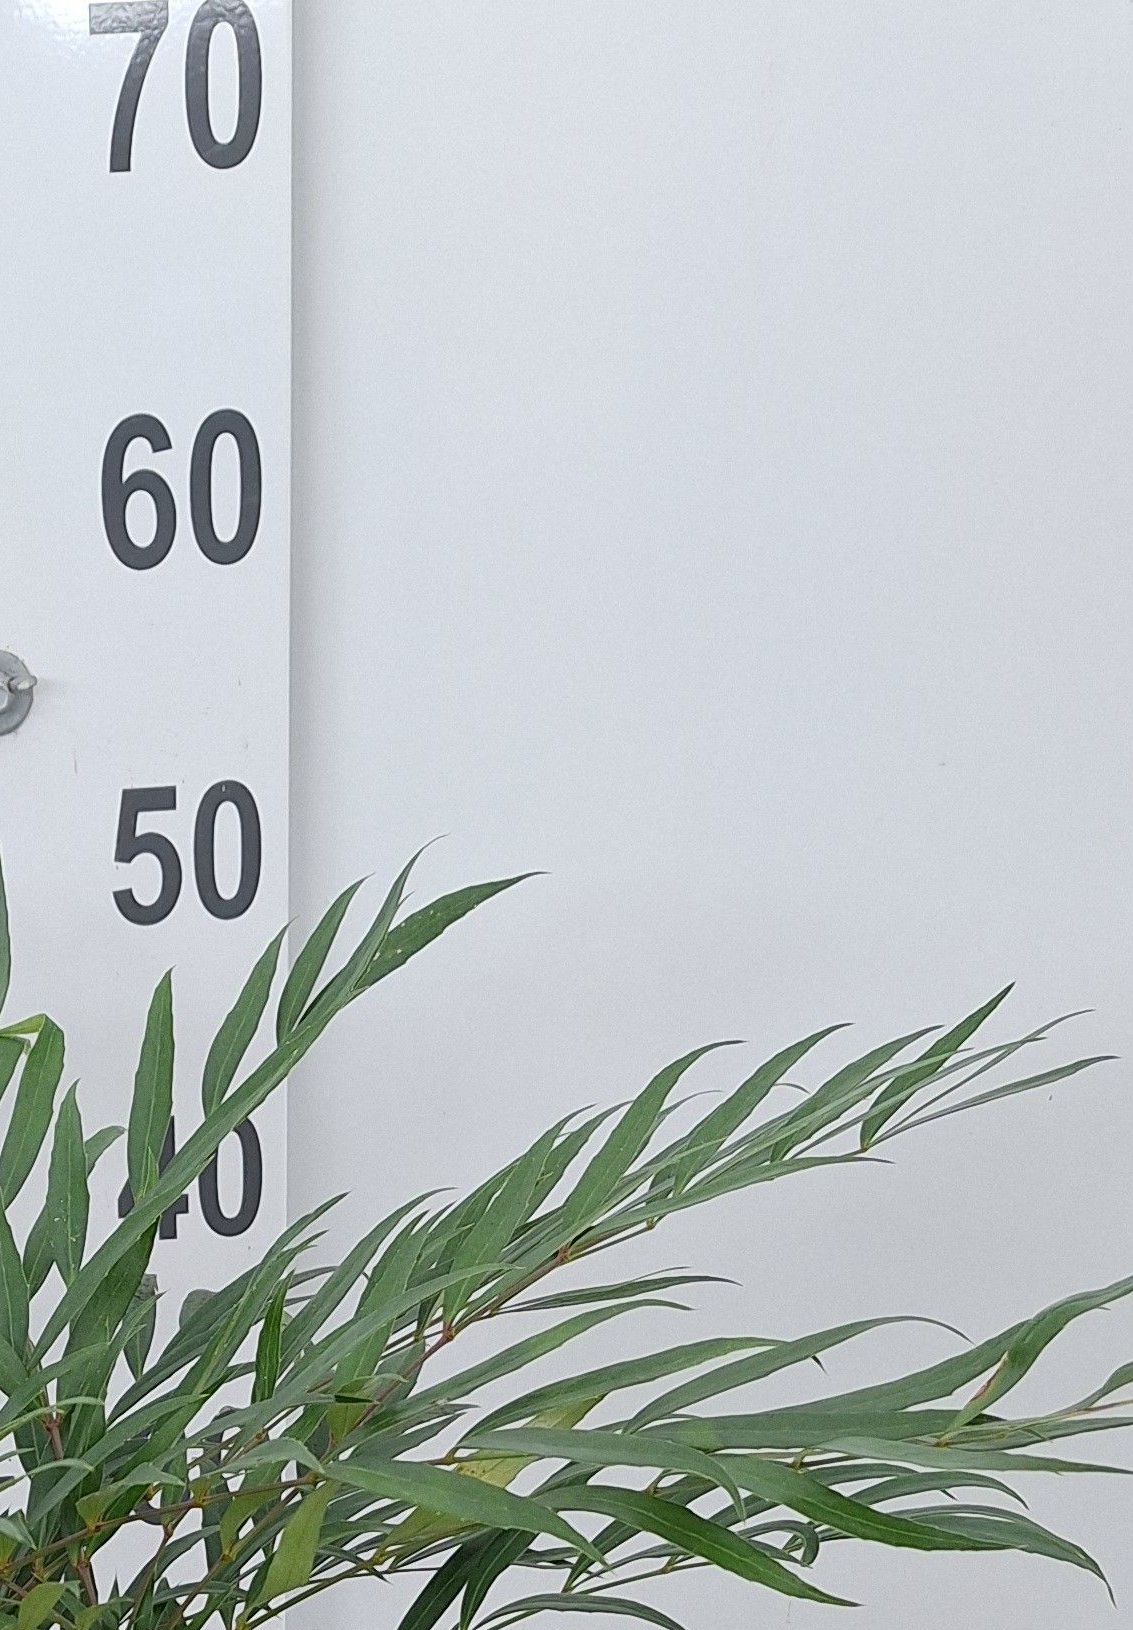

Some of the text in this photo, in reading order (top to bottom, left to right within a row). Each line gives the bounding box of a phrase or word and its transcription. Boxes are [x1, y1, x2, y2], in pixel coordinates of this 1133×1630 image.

[89, 0, 262, 173] 70
[101, 408, 262, 571] 60
[112, 780, 262, 926] 50
